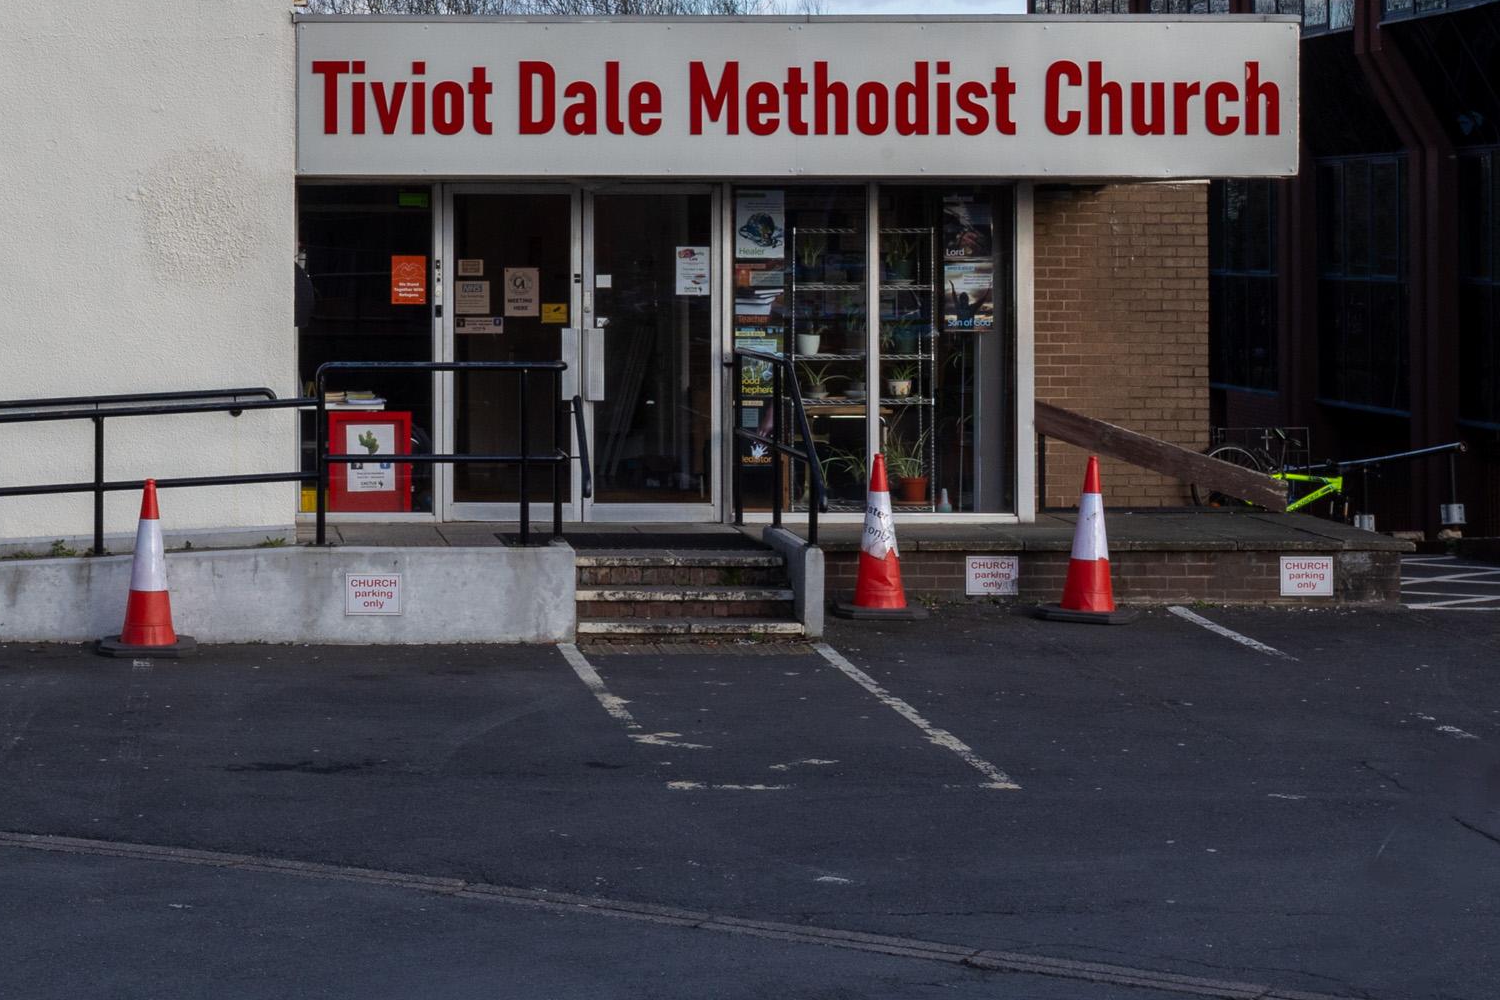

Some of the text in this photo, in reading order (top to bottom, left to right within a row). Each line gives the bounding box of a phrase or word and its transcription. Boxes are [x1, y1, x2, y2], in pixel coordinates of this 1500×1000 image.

[312, 59, 1281, 136] Tiviot Dale Methodist Church
[946, 248, 965, 256] Lord
[741, 376, 760, 385] ood
[741, 385, 773, 395] hepher
[867, 505, 889, 519] ster
[971, 561, 1014, 569] CHURCH
[1285, 562, 1329, 570] CHURCH
[974, 571, 1011, 580] parking
[1289, 572, 1325, 581] parking
[350, 579, 397, 587] CHURCH
[982, 581, 1002, 589] only
[1297, 581, 1317, 590] only
[355, 589, 393, 599] parking
[363, 599, 384, 609] only
